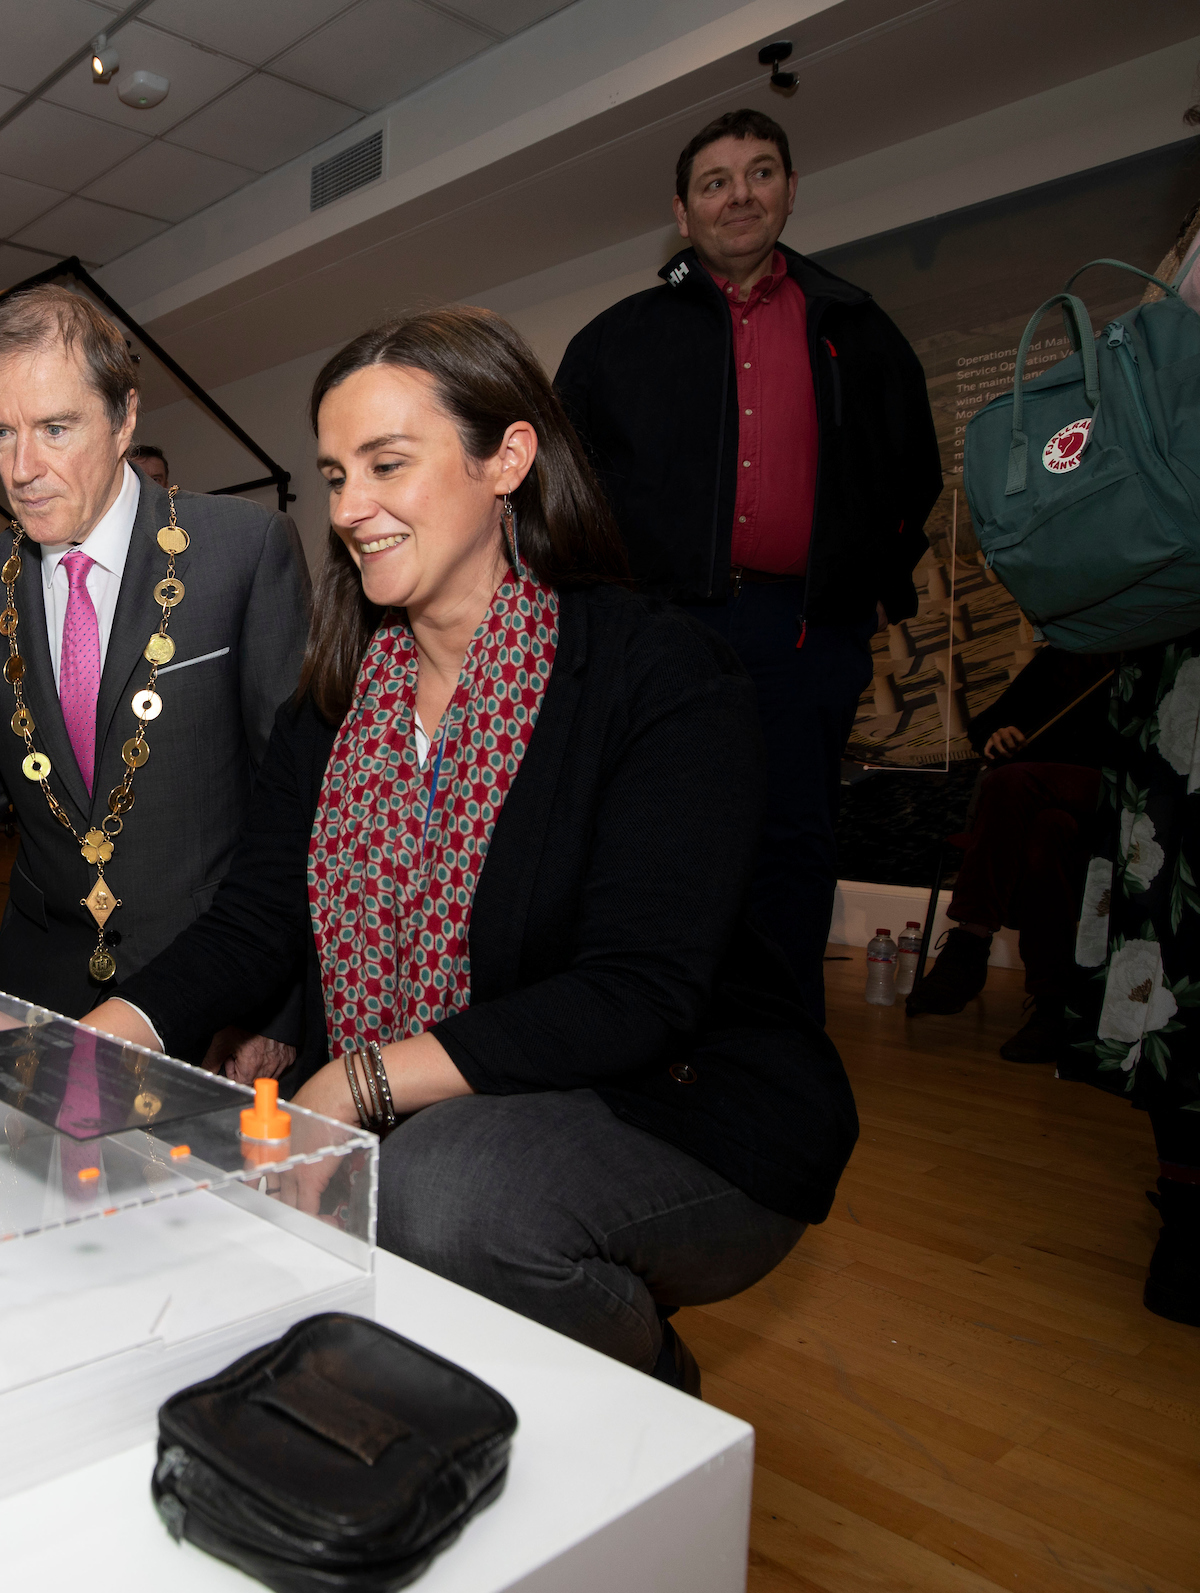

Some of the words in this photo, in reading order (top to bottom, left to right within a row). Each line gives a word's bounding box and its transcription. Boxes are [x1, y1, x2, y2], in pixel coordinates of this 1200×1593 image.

[956, 347, 1018, 367] Operations
[1027, 341, 1042, 352] nd
[956, 366, 998, 380] Service
[1000, 353, 1057, 372] Opation
[956, 383, 977, 393] The
[956, 393, 983, 406] wind
